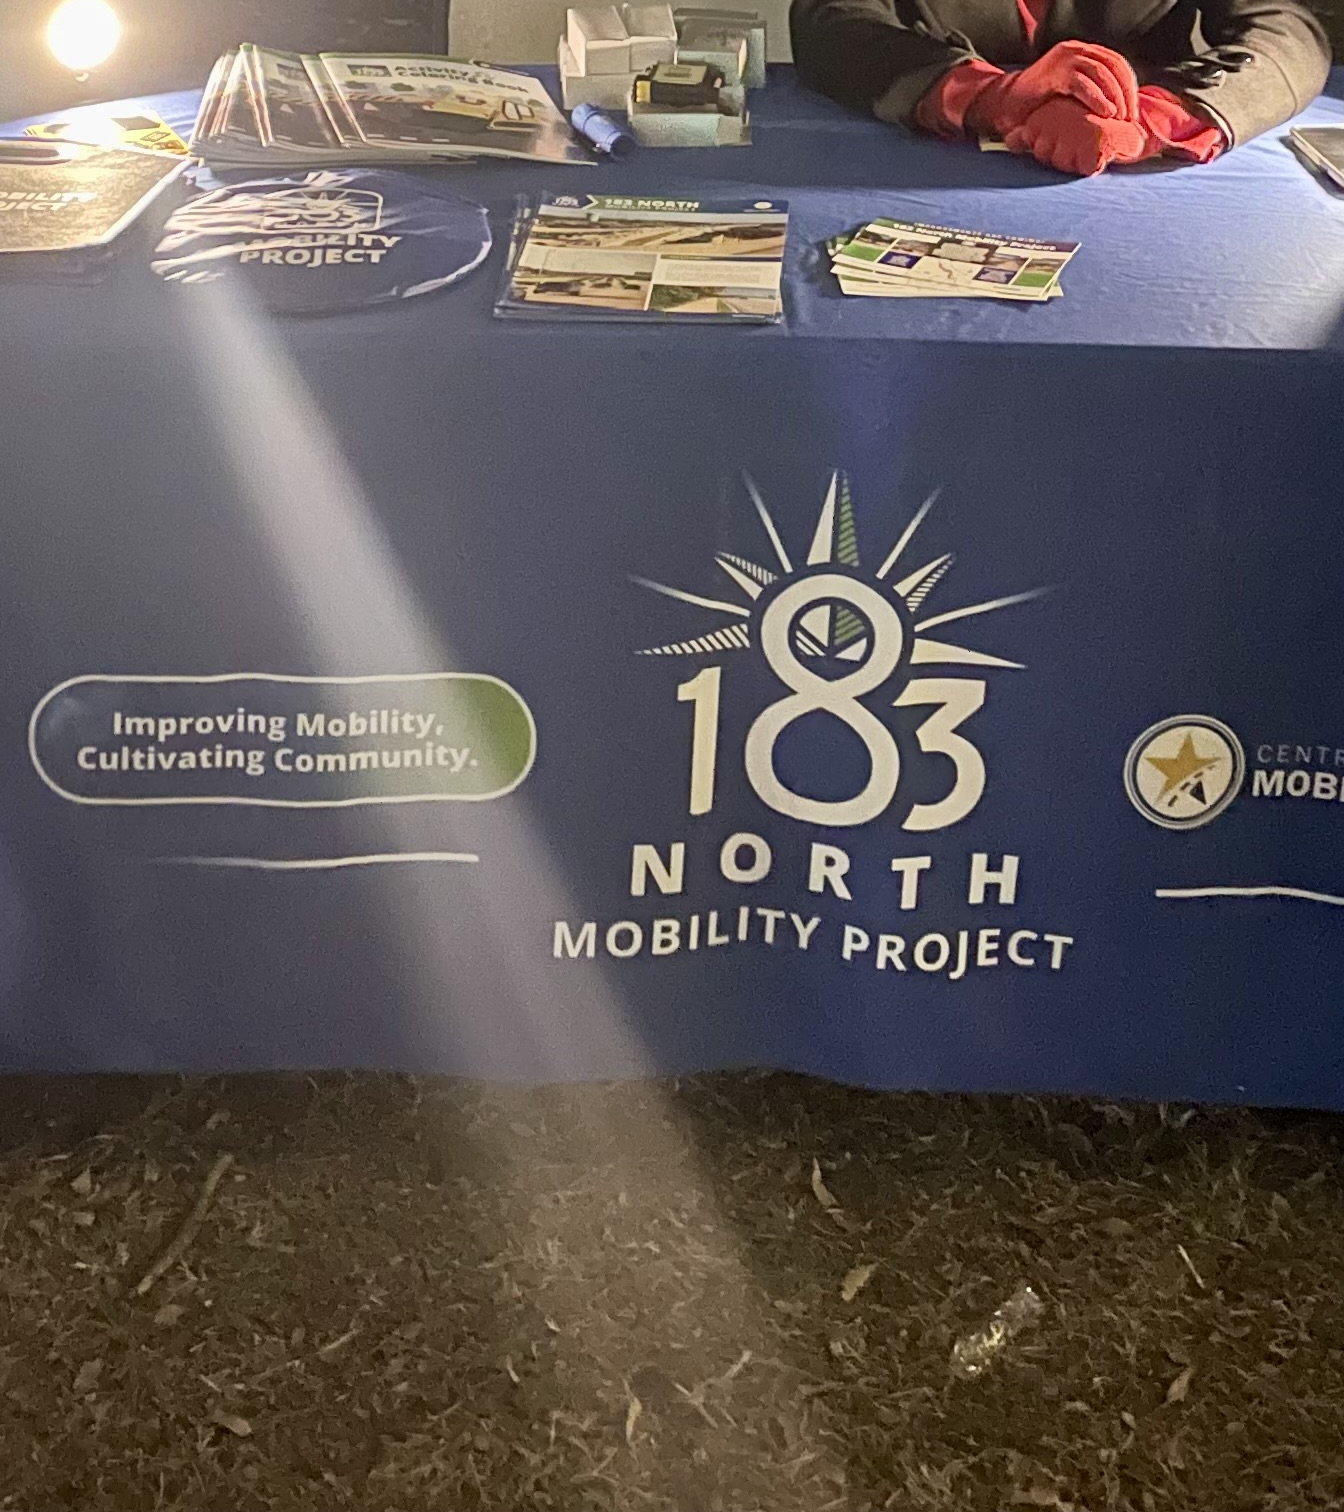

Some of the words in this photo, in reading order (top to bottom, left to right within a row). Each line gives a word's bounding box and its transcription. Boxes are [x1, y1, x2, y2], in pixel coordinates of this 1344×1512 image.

[394, 66, 470, 77] Activity
[398, 71, 478, 85] Coloring
[483, 78, 529, 93] Book
[637, 199, 700, 209] NORTH
[915, 227, 953, 239] North
[1010, 240, 1056, 251] Project
[239, 249, 387, 268] PROJECT
[677, 572, 987, 831] 183
[113, 707, 286, 742] Improving
[296, 708, 445, 739] Mobility,
[77, 745, 265, 776] Cultivating
[274, 745, 478, 774] Community.
[631, 832, 1019, 910] NORTH
[552, 906, 821, 959] MOBILITY
[842, 925, 1074, 980] PROJECT
